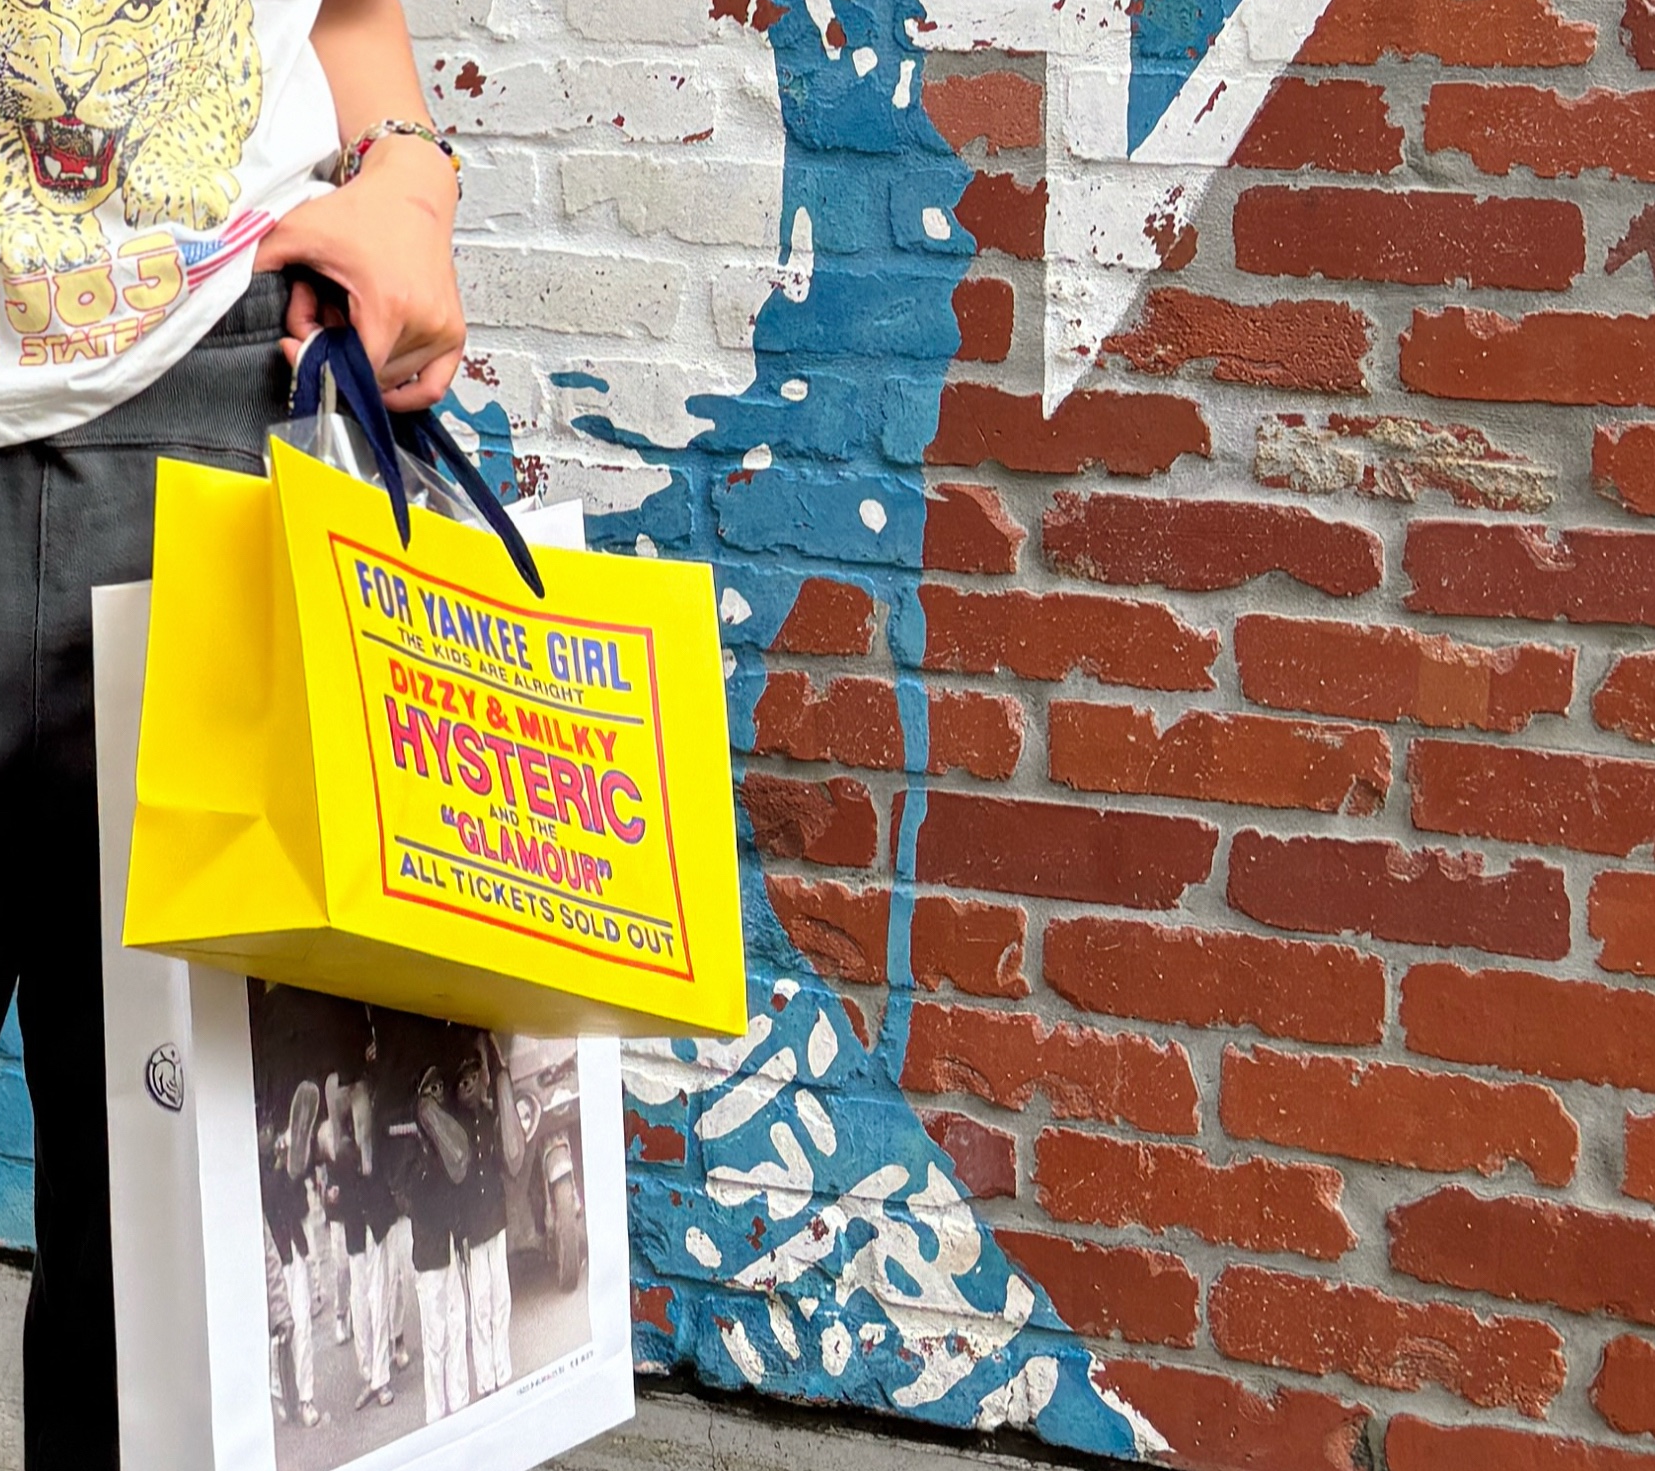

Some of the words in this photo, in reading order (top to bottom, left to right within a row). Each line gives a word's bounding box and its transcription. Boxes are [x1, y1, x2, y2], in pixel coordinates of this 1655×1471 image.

[354, 558, 414, 628] FOR
[417, 585, 534, 672] YANKEE
[546, 630, 632, 692] GIRL
[397, 626, 426, 654] THE
[432, 641, 473, 668] KIDS
[479, 657, 508, 682] ARE
[513, 670, 586, 706] ALRIGHT
[388, 656, 477, 721] DIZZY
[486, 695, 515, 735] &
[515, 705, 618, 763] MILKY
[383, 693, 647, 846] HYSTERIC
[489, 803, 520, 828] AND
[527, 815, 558, 842] THE
[400, 851, 447, 889] ALL
[450, 865, 555, 924] TICKETS
[559, 903, 621, 943] SOLD
[627, 923, 674, 958] OUT
